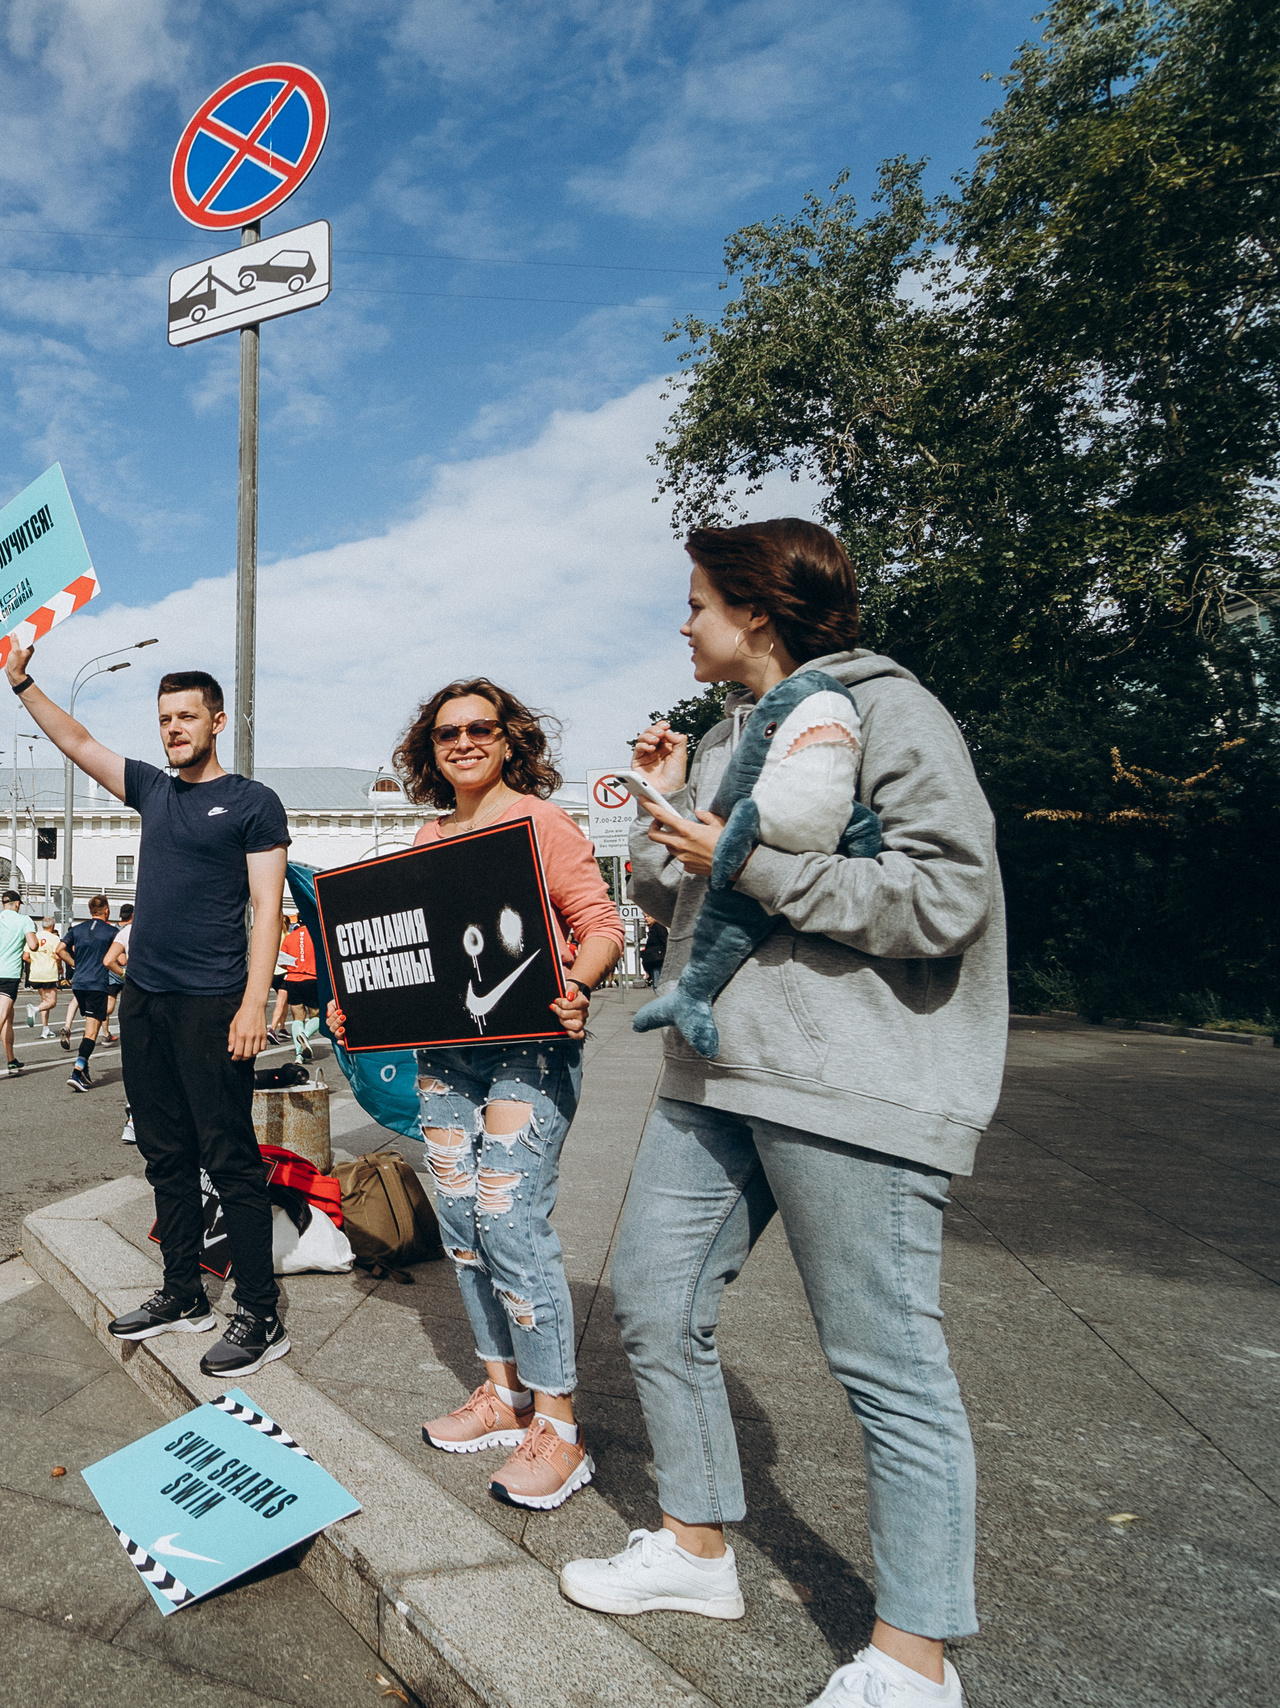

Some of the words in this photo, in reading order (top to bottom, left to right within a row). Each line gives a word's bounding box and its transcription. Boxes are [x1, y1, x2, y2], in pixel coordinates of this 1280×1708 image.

[1, 586, 34, 619] СПРАШИВАЙ
[594, 816, 633, 824] 7.00-22.00
[335, 908, 429, 956] СТРАДАНИЯ
[341, 947, 435, 994] ВРЕМЕННЫ!
[159, 1472, 227, 1520] SWIM
[163, 1430, 226, 1472] SWIM
[207, 1458, 299, 1520] SHARKS
